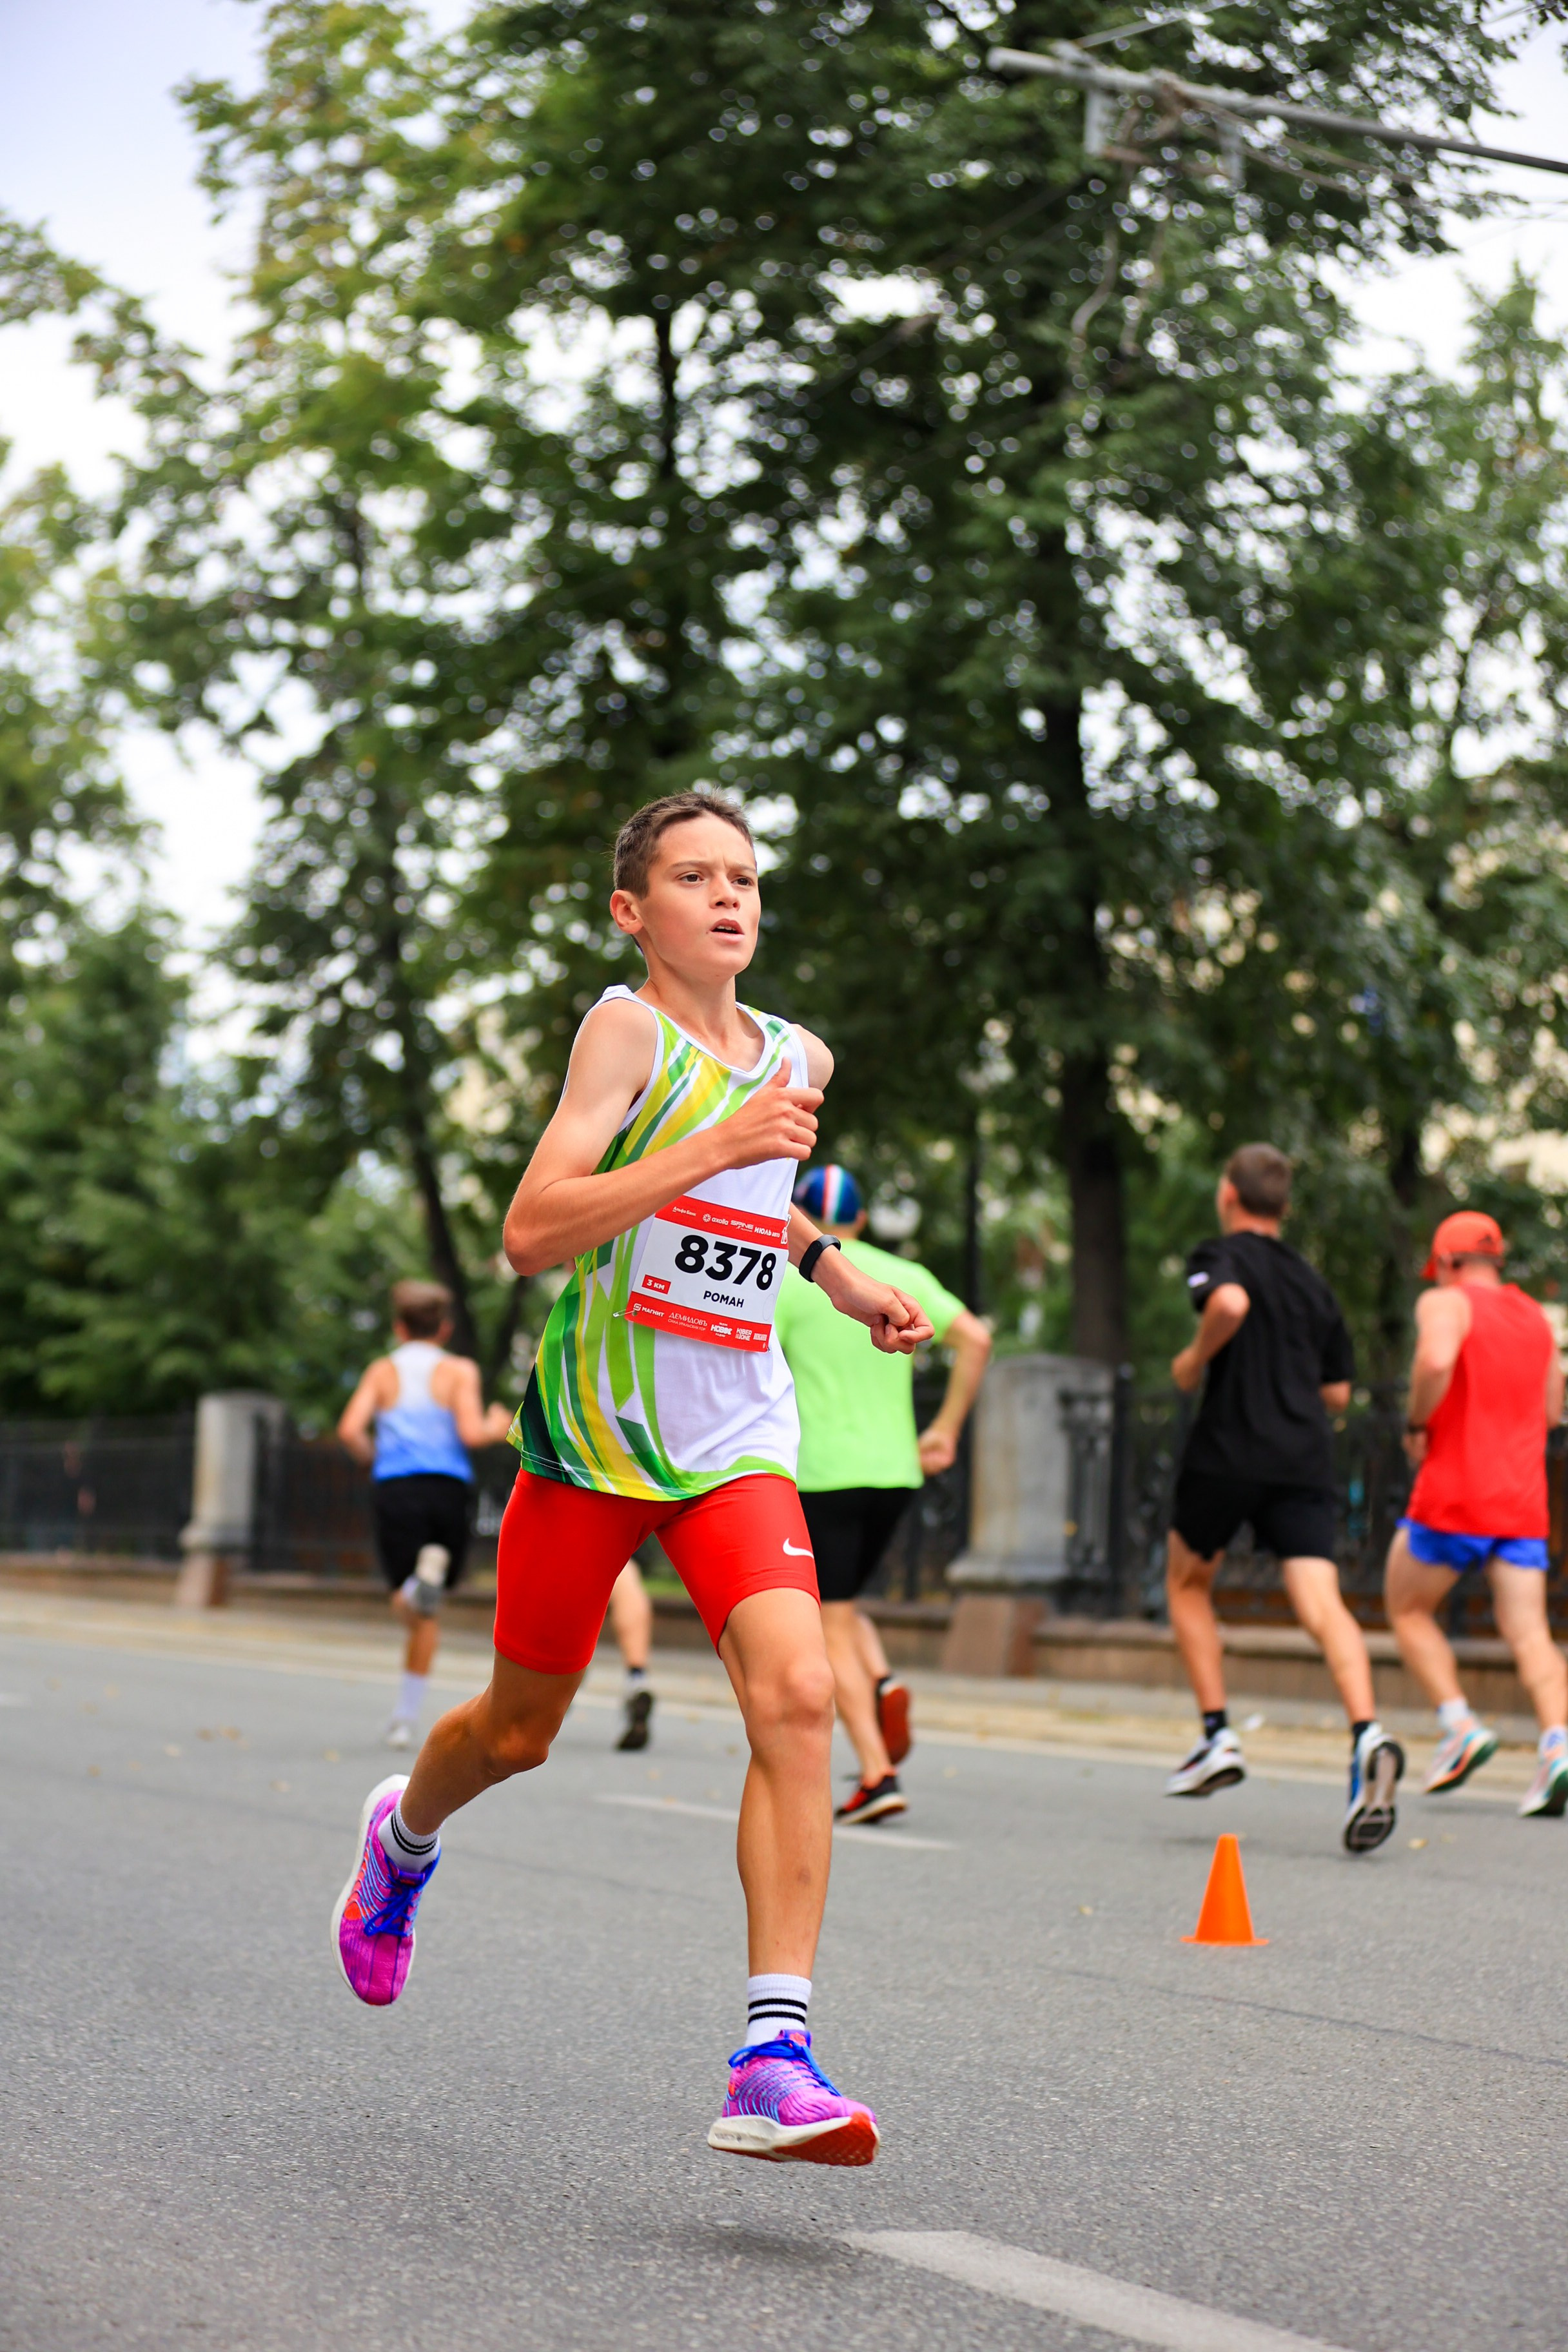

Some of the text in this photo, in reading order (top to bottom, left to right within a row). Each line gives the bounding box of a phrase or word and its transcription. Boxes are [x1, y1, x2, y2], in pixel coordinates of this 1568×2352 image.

[730, 1220, 754, 1230] SPINE
[754, 1227, 772, 1237] ИЮЛЬ
[674, 1235, 776, 1291] 8378
[703, 1290, 744, 1308] РОМАН
[642, 1306, 665, 1317] МАГНИТ
[669, 1312, 708, 1327] ДЕМИДОВЪ
[736, 1328, 752, 1336] KIBER
